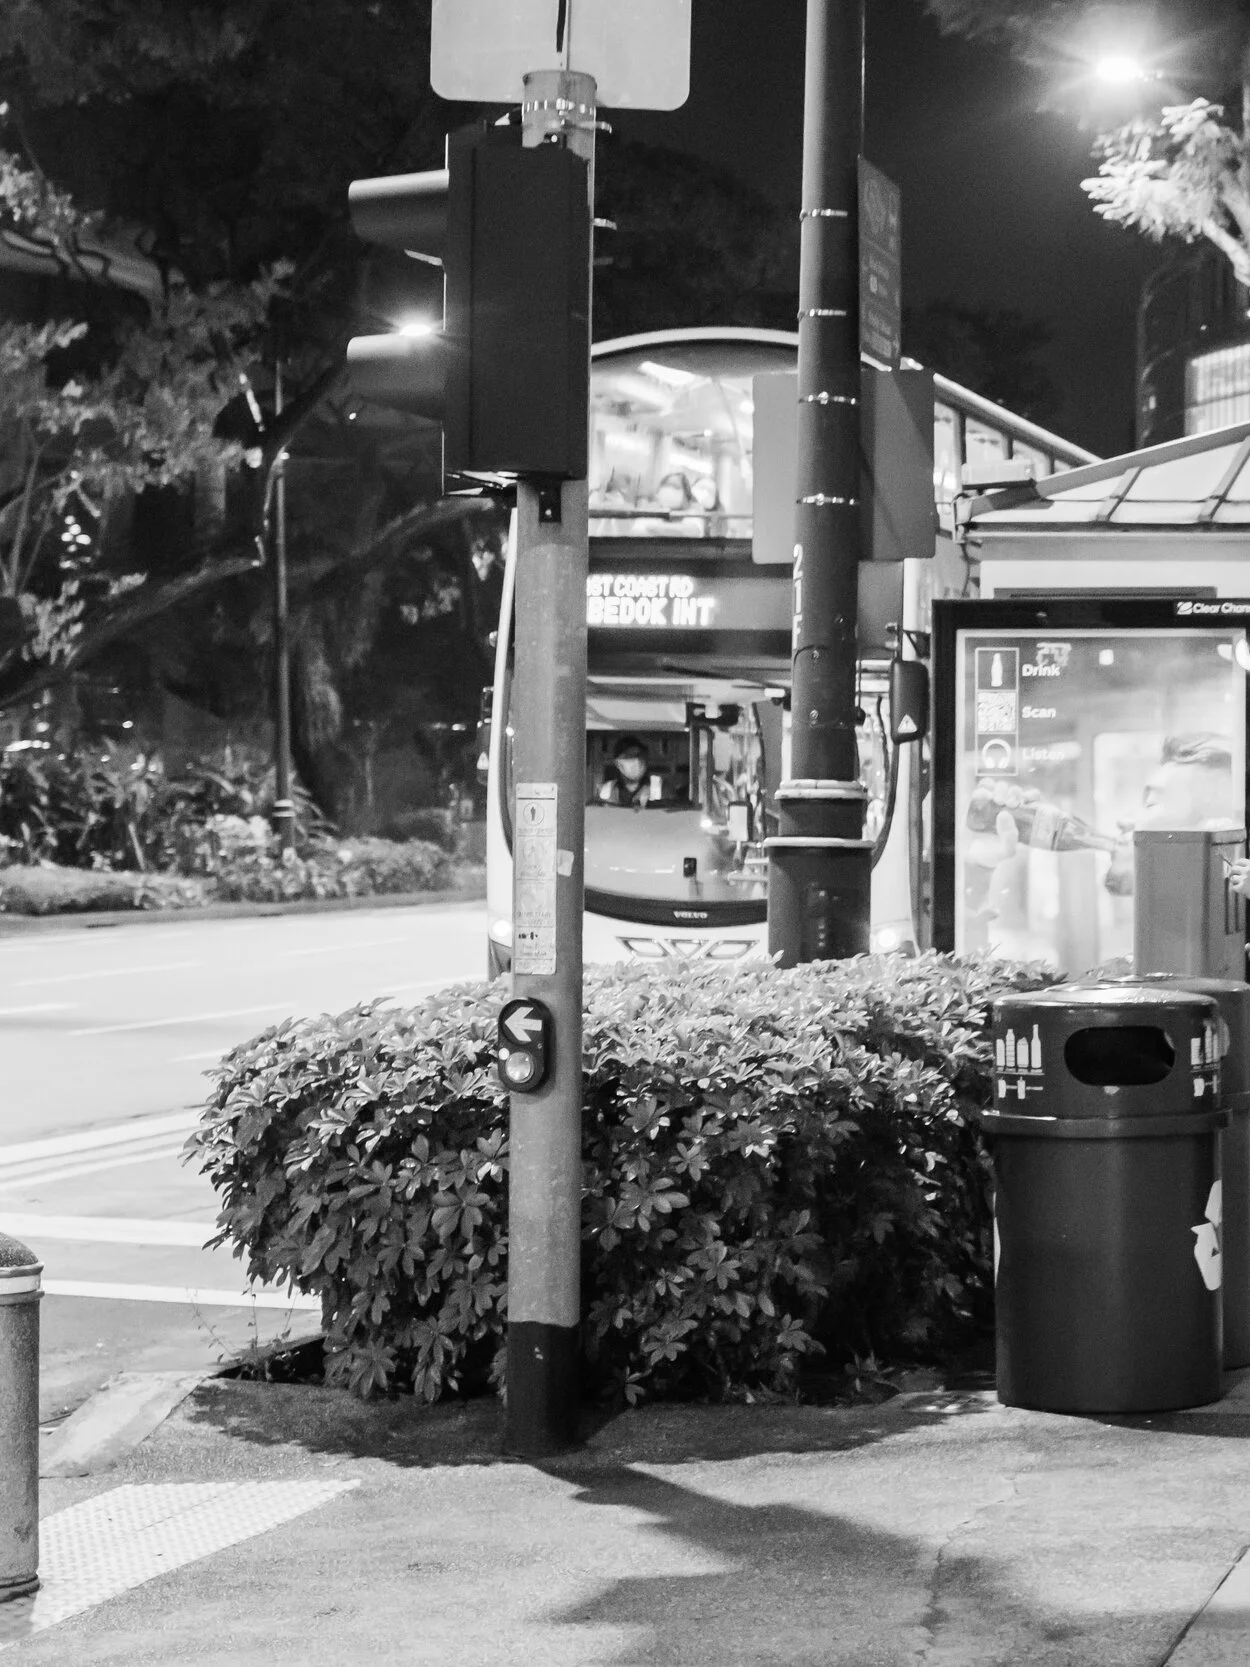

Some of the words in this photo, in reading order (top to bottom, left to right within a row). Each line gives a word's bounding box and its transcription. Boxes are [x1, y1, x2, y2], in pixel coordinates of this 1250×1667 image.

[587, 597, 668, 625] BEDOK
[672, 597, 715, 626] INT
[1193, 602, 1220, 614] Clear
[1022, 663, 1061, 677] Drink
[1022, 706, 1056, 718] Scan
